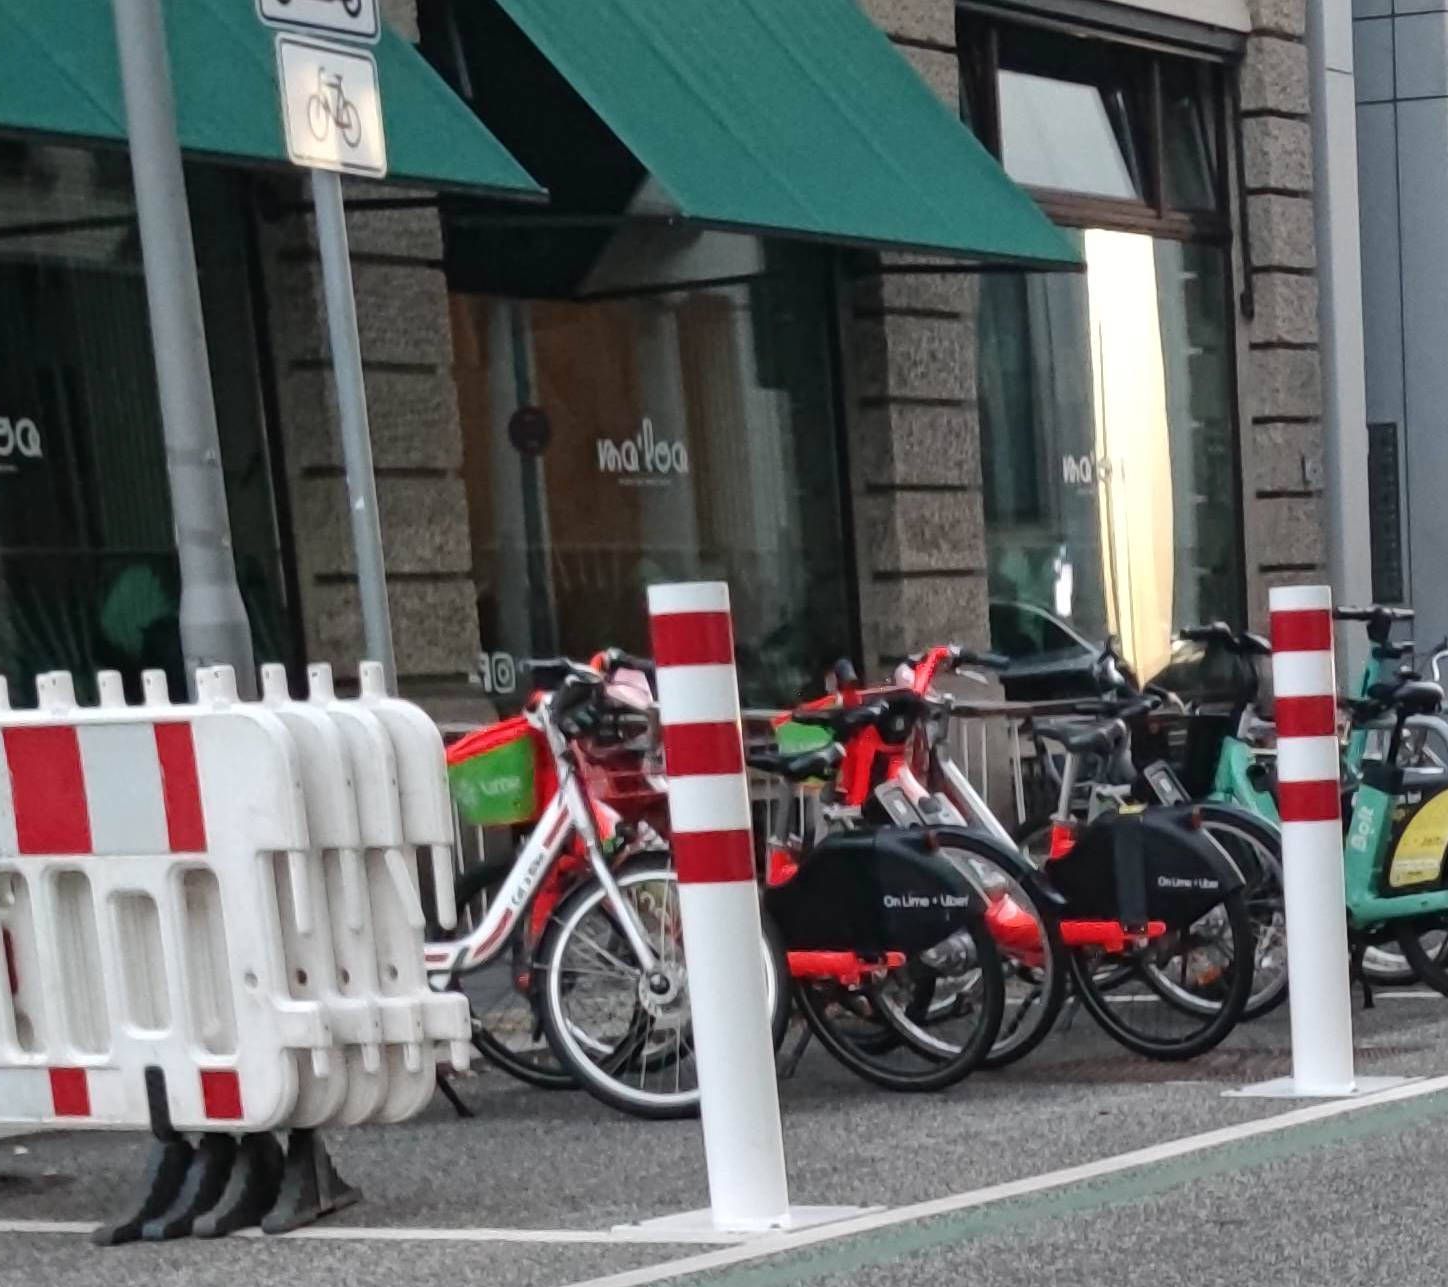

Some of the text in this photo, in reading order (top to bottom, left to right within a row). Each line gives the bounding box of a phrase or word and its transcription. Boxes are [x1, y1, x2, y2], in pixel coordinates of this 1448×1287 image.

[883, 894, 901, 908] On
[902, 893, 930, 908] Lime
[940, 894, 969, 908] Uber
